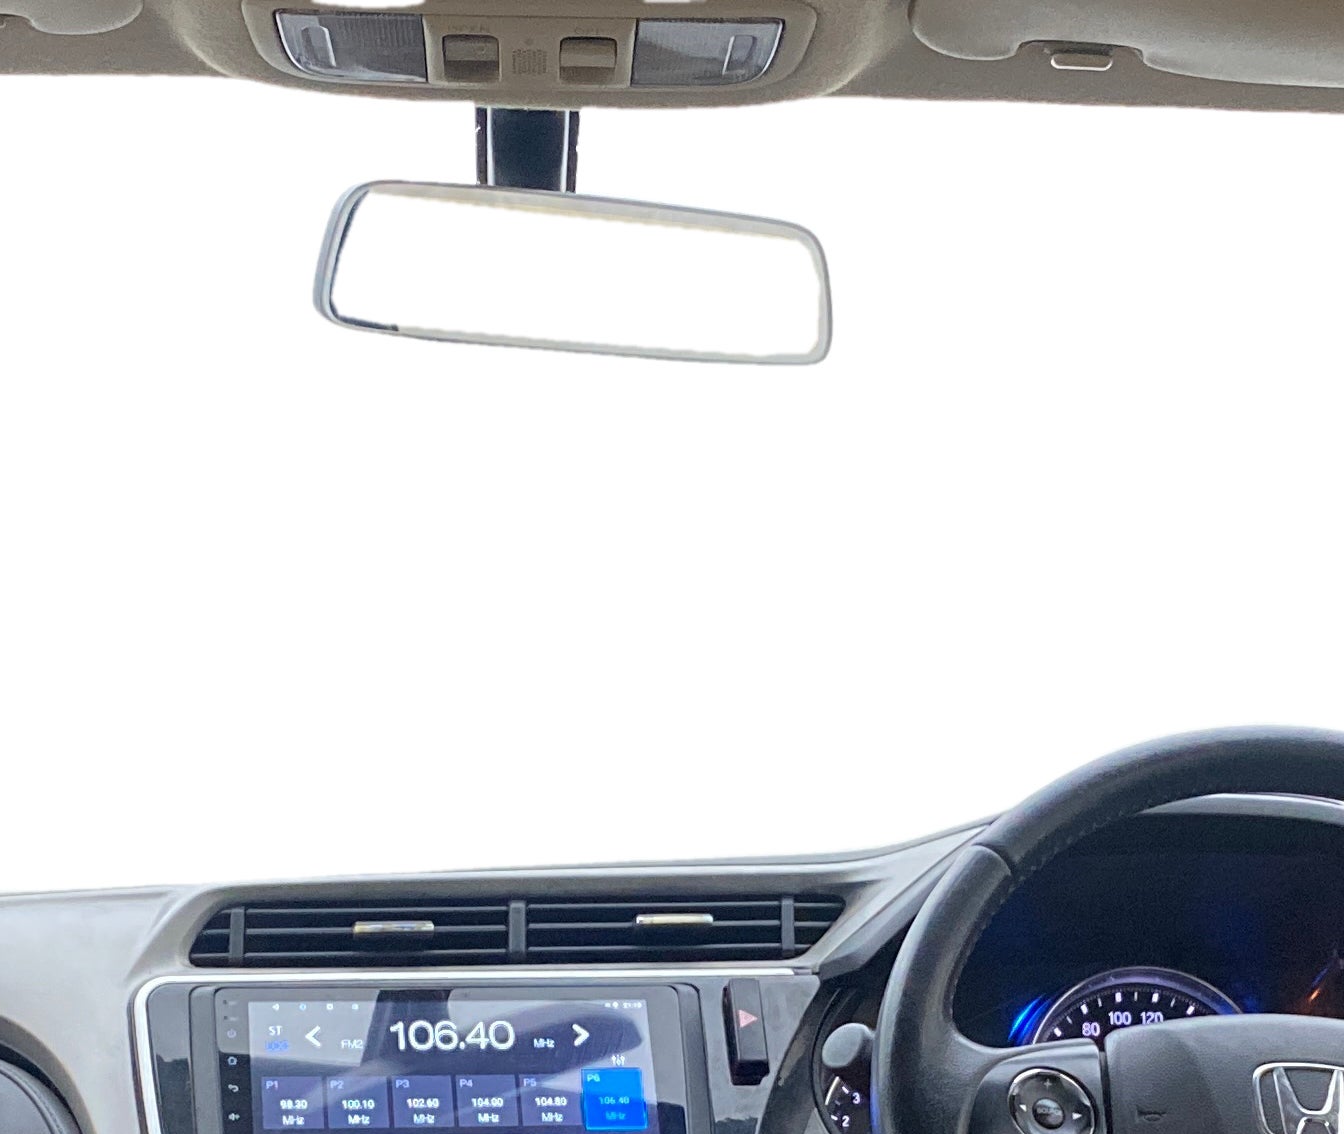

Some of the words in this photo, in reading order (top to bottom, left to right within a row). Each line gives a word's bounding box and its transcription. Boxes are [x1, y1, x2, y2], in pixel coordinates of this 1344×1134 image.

[1108, 1011, 1132, 1026] 100
[1140, 1011, 1164, 1025] 120
[268, 1025, 283, 1036] ST
[1081, 1022, 1100, 1036] 80
[341, 1039, 364, 1049] FM2
[390, 1019, 516, 1051] 106.40
[533, 1038, 555, 1048] MHz
[523, 1078, 537, 1086] P5
[586, 1073, 601, 1082] P6
[266, 1081, 279, 1089] P1
[330, 1080, 344, 1089] P2
[395, 1079, 410, 1088] P3
[459, 1079, 473, 1087] P4
[406, 1098, 440, 1108] 102.60
[471, 1097, 504, 1108] 104.00
[534, 1096, 568, 1107] 104.80
[852, 1091, 861, 1105] 3
[341, 1099, 375, 1110] 100.10
[282, 1115, 305, 1125] MHz
[347, 1115, 370, 1125] MHz
[413, 1114, 435, 1124] MHz
[477, 1113, 500, 1123] MHz
[541, 1112, 564, 1122] MHz
[842, 1115, 850, 1127] 2
